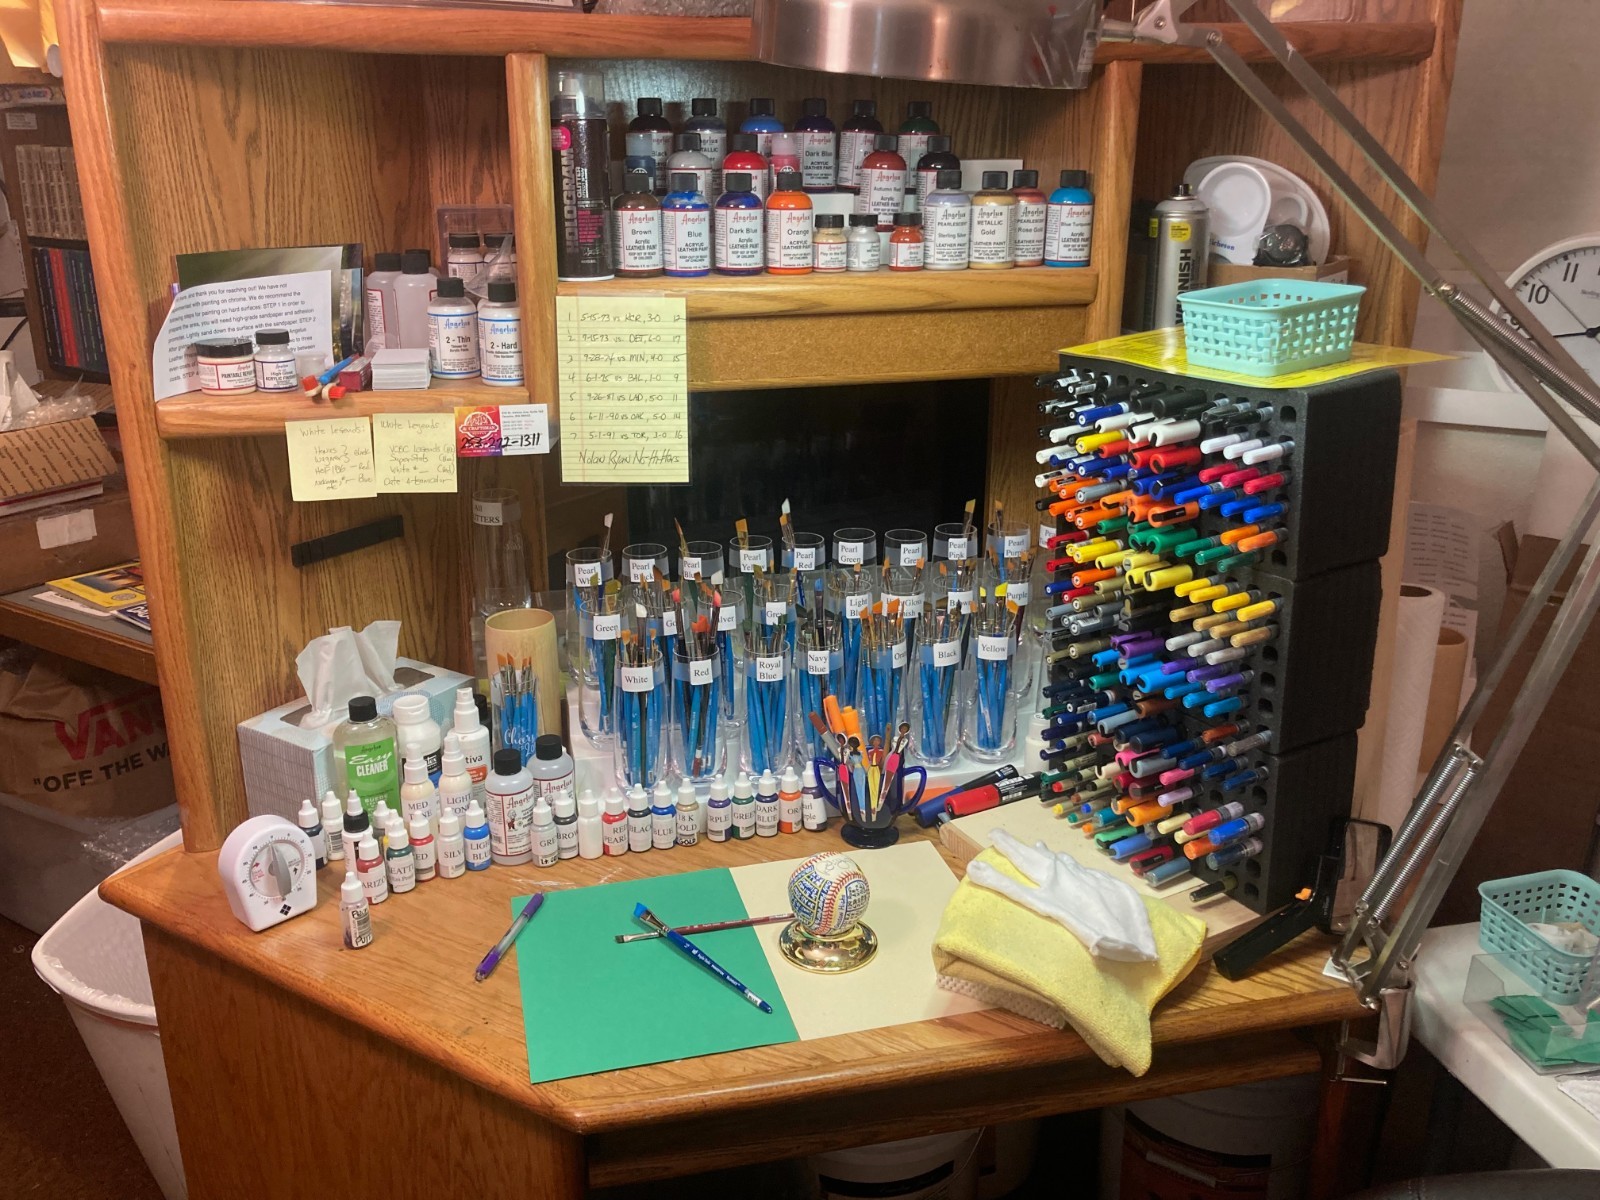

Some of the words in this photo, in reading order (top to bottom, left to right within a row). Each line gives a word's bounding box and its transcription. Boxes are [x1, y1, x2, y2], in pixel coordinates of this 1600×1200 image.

[877, 171, 901, 182] Angelus
[941, 209, 966, 220] Angelus
[978, 208, 1003, 218] Angelus
[1021, 207, 1044, 217] Angelus
[1066, 208, 1091, 218] Angelus
[628, 213, 654, 224] Angelus
[681, 214, 706, 225] Angelus
[733, 212, 758, 223] Angelus
[786, 212, 811, 225] Angelus
[1563, 262, 1579, 282] 11
[1176, 248, 1192, 325] VANISH
[1528, 284, 1550, 304] 10
[202, 308, 220, 317] painting
[232, 314, 258, 322] high-grade
[444, 318, 470, 330] Angelus
[490, 323, 517, 335] Angelus
[568, 372, 576, 383] 4
[674, 373, 679, 381] 9
[569, 392, 576, 401] 5
[673, 393, 678, 401] 11
[569, 412, 576, 421] 6
[588, 412, 619, 420] 6-11-90
[381, 419, 403, 429] White
[300, 428, 325, 438] White
[675, 431, 683, 439] 16
[579, 449, 605, 464] Nolan
[608, 449, 632, 470] Ryan
[840, 545, 857, 553] Pearl
[949, 541, 966, 549] Pearl
[796, 551, 813, 559] Pearl
[841, 555, 861, 563] Green
[949, 551, 965, 559] Pink
[632, 562, 650, 570] Pearl
[684, 560, 700, 568] Pearl
[578, 566, 597, 575] Pearl
[1006, 592, 1028, 601] Purple
[850, 599, 868, 607] Light
[595, 623, 619, 632] Green
[981, 644, 1006, 652] Yellow
[808, 654, 828, 663] Navy
[938, 651, 957, 659] Black
[759, 660, 781, 669] Royal
[808, 665, 826, 673] Blue
[694, 669, 709, 677] Red
[759, 672, 777, 680] Blue
[624, 675, 649, 684] White
[54, 688, 158, 761] VAN
[348, 751, 393, 765] Easy
[100, 753, 144, 780] THE
[356, 760, 388, 777] CLEANER
[544, 780, 573, 794] Angelus
[408, 801, 428, 810] MED
[709, 814, 729, 823] RPLE
[757, 814, 777, 823] BLUE
